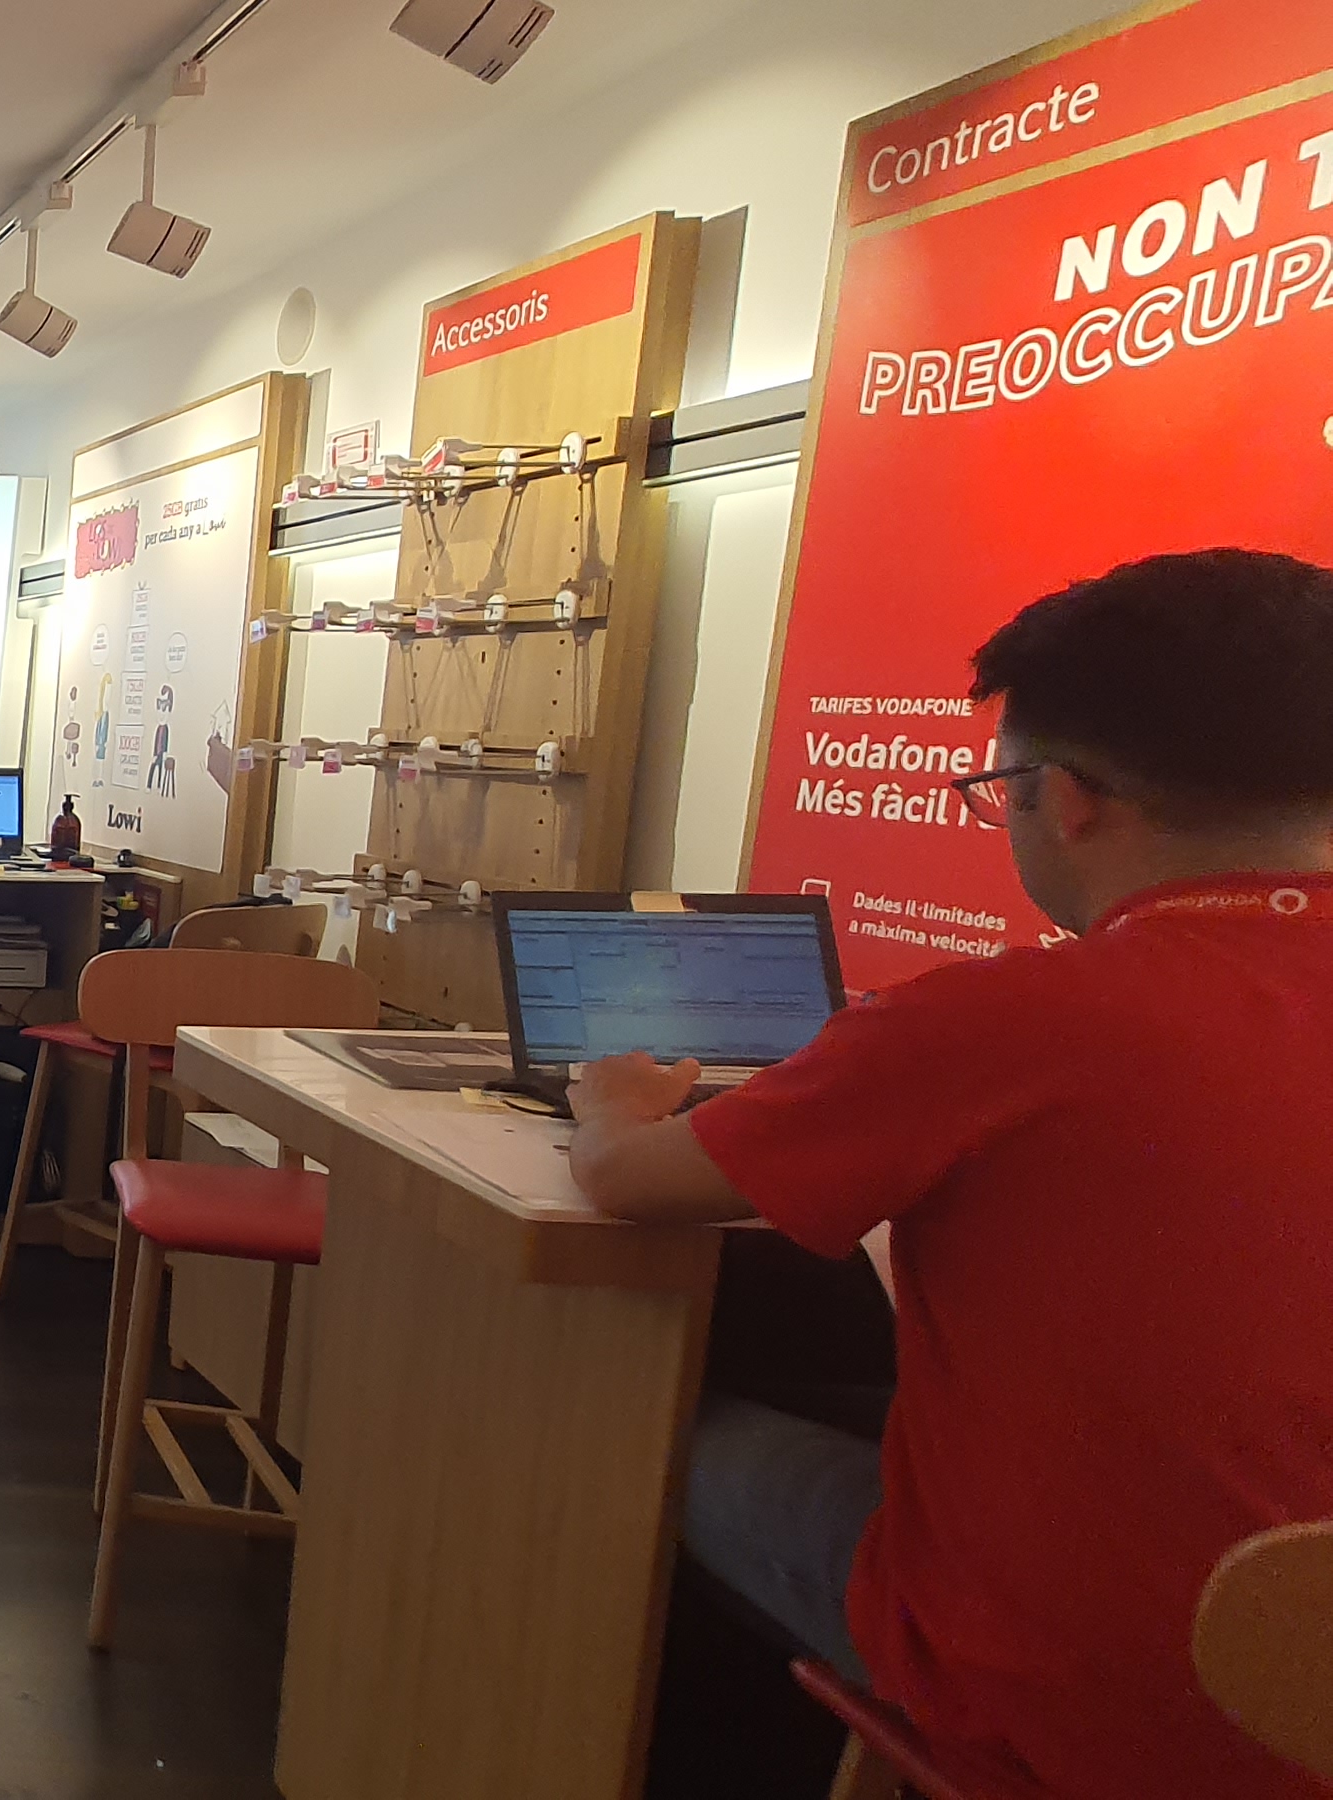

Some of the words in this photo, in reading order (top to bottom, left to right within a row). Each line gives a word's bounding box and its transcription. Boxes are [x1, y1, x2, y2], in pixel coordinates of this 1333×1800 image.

[866, 80, 1100, 194] Contracte
[1053, 158, 1268, 302] NON
[431, 289, 549, 357] Accessoris
[810, 696, 872, 714] TARIFES
[876, 697, 974, 717] VODAFONE
[805, 731, 973, 775] Vodafone
[107, 804, 142, 833] Lowi
[795, 777, 865, 817] Més
[871, 782, 949, 827] fàcil
[853, 891, 902, 915] Dades
[848, 920, 857, 933] a
[861, 920, 926, 945] màxima
